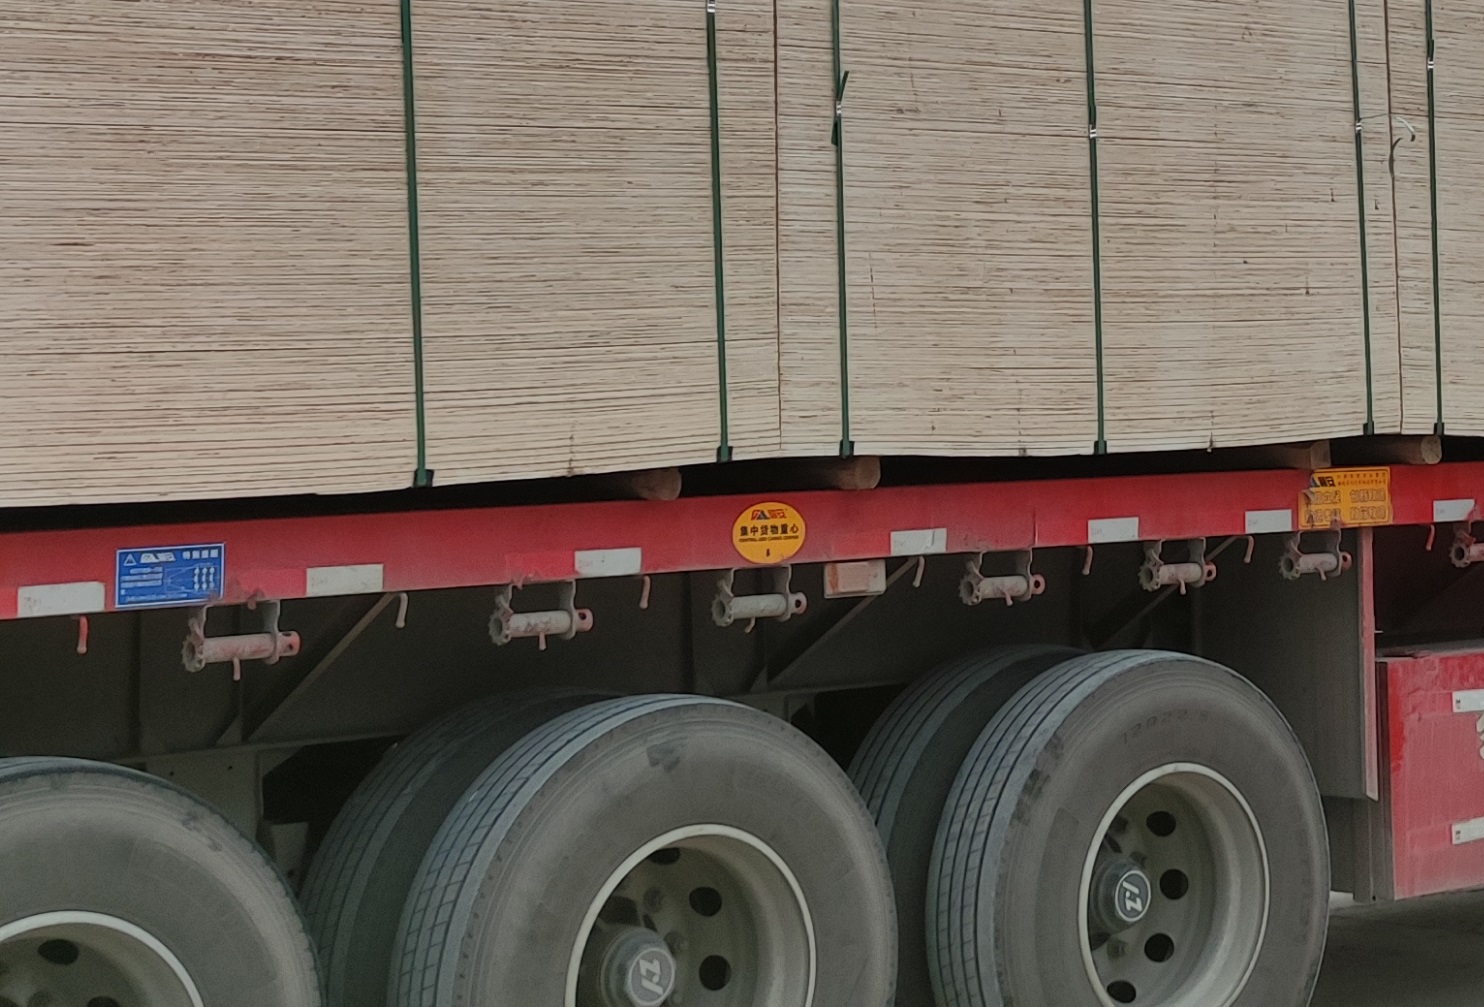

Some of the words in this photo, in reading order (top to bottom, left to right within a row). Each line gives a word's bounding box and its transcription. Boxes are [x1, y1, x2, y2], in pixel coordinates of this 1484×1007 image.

[740, 523, 799, 537] 集中货物重心
